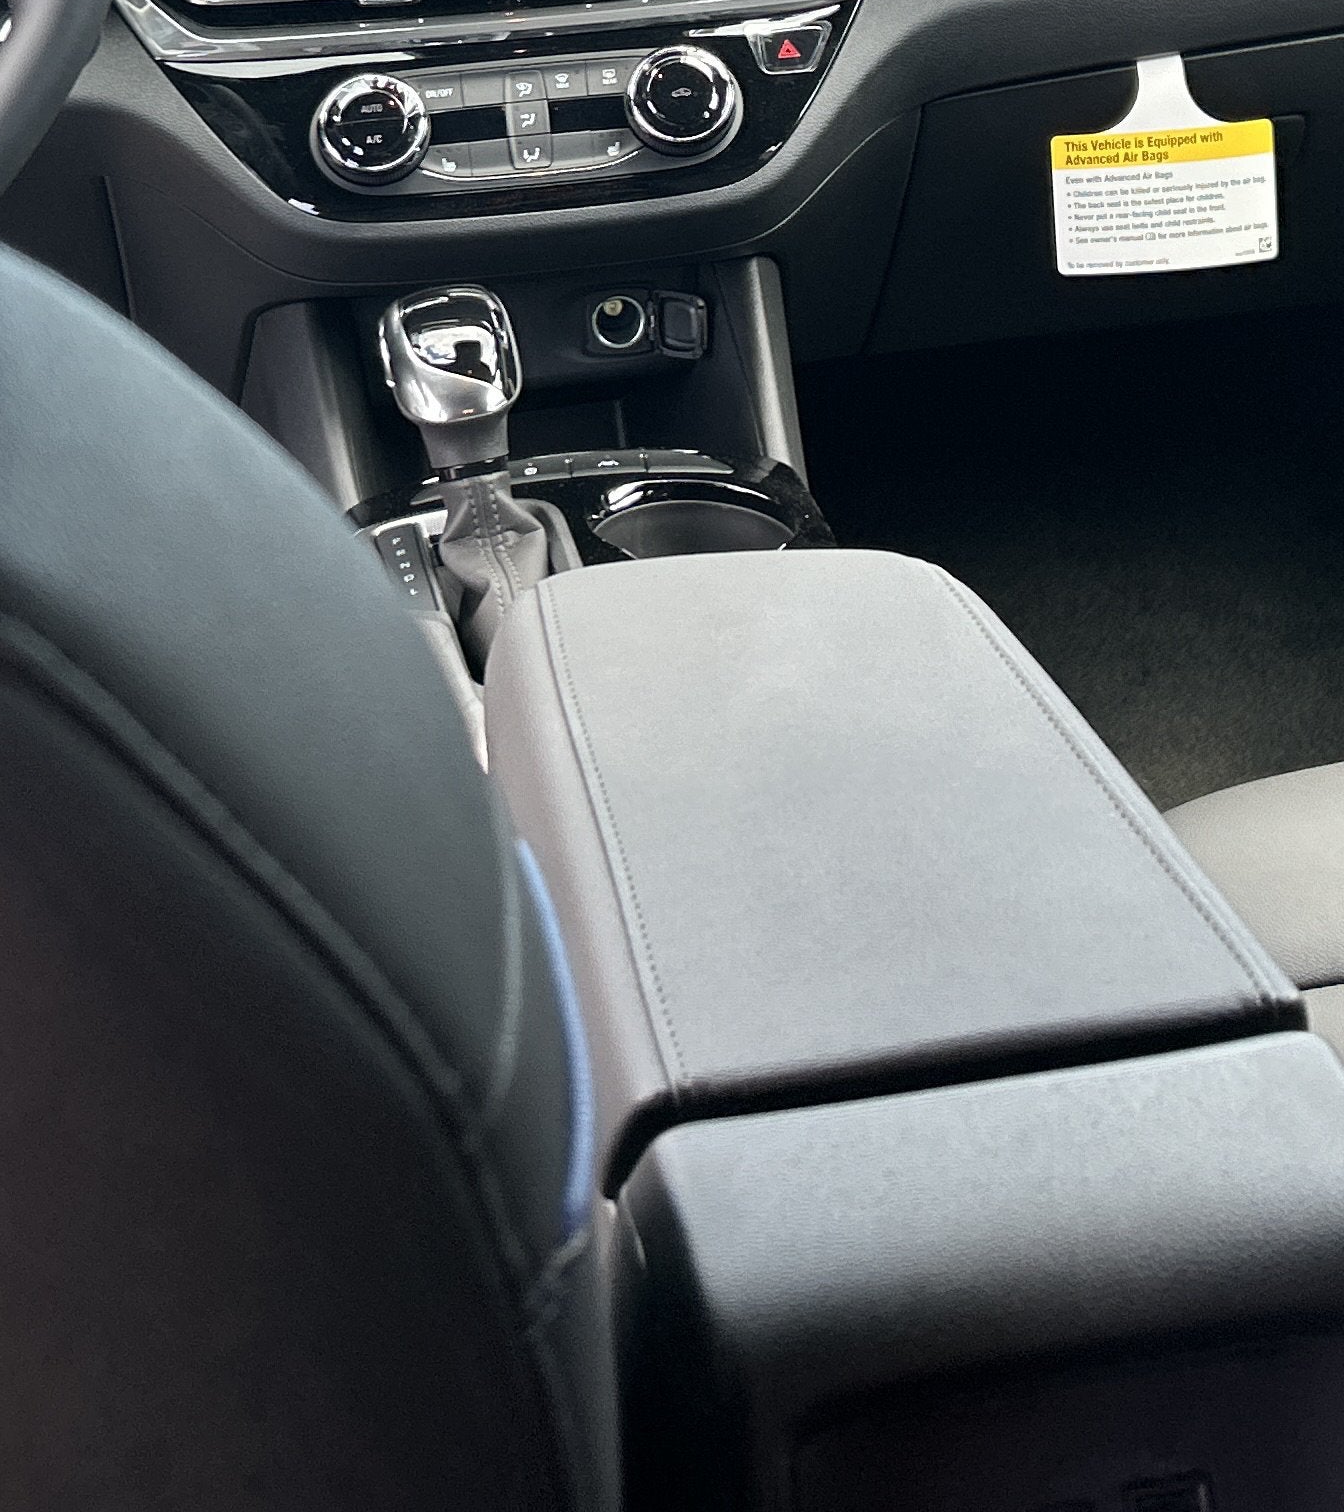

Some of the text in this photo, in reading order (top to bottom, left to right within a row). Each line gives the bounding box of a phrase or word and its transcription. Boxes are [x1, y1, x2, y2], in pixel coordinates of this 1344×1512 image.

[361, 104, 383, 114] AUTO
[366, 135, 383, 144] A/C
[1064, 140, 1088, 152] This
[1091, 139, 1131, 150] Vehicle
[1148, 133, 1197, 148] Equipped
[1200, 131, 1223, 142] with
[1066, 150, 1169, 166] Advanced Air Bags
